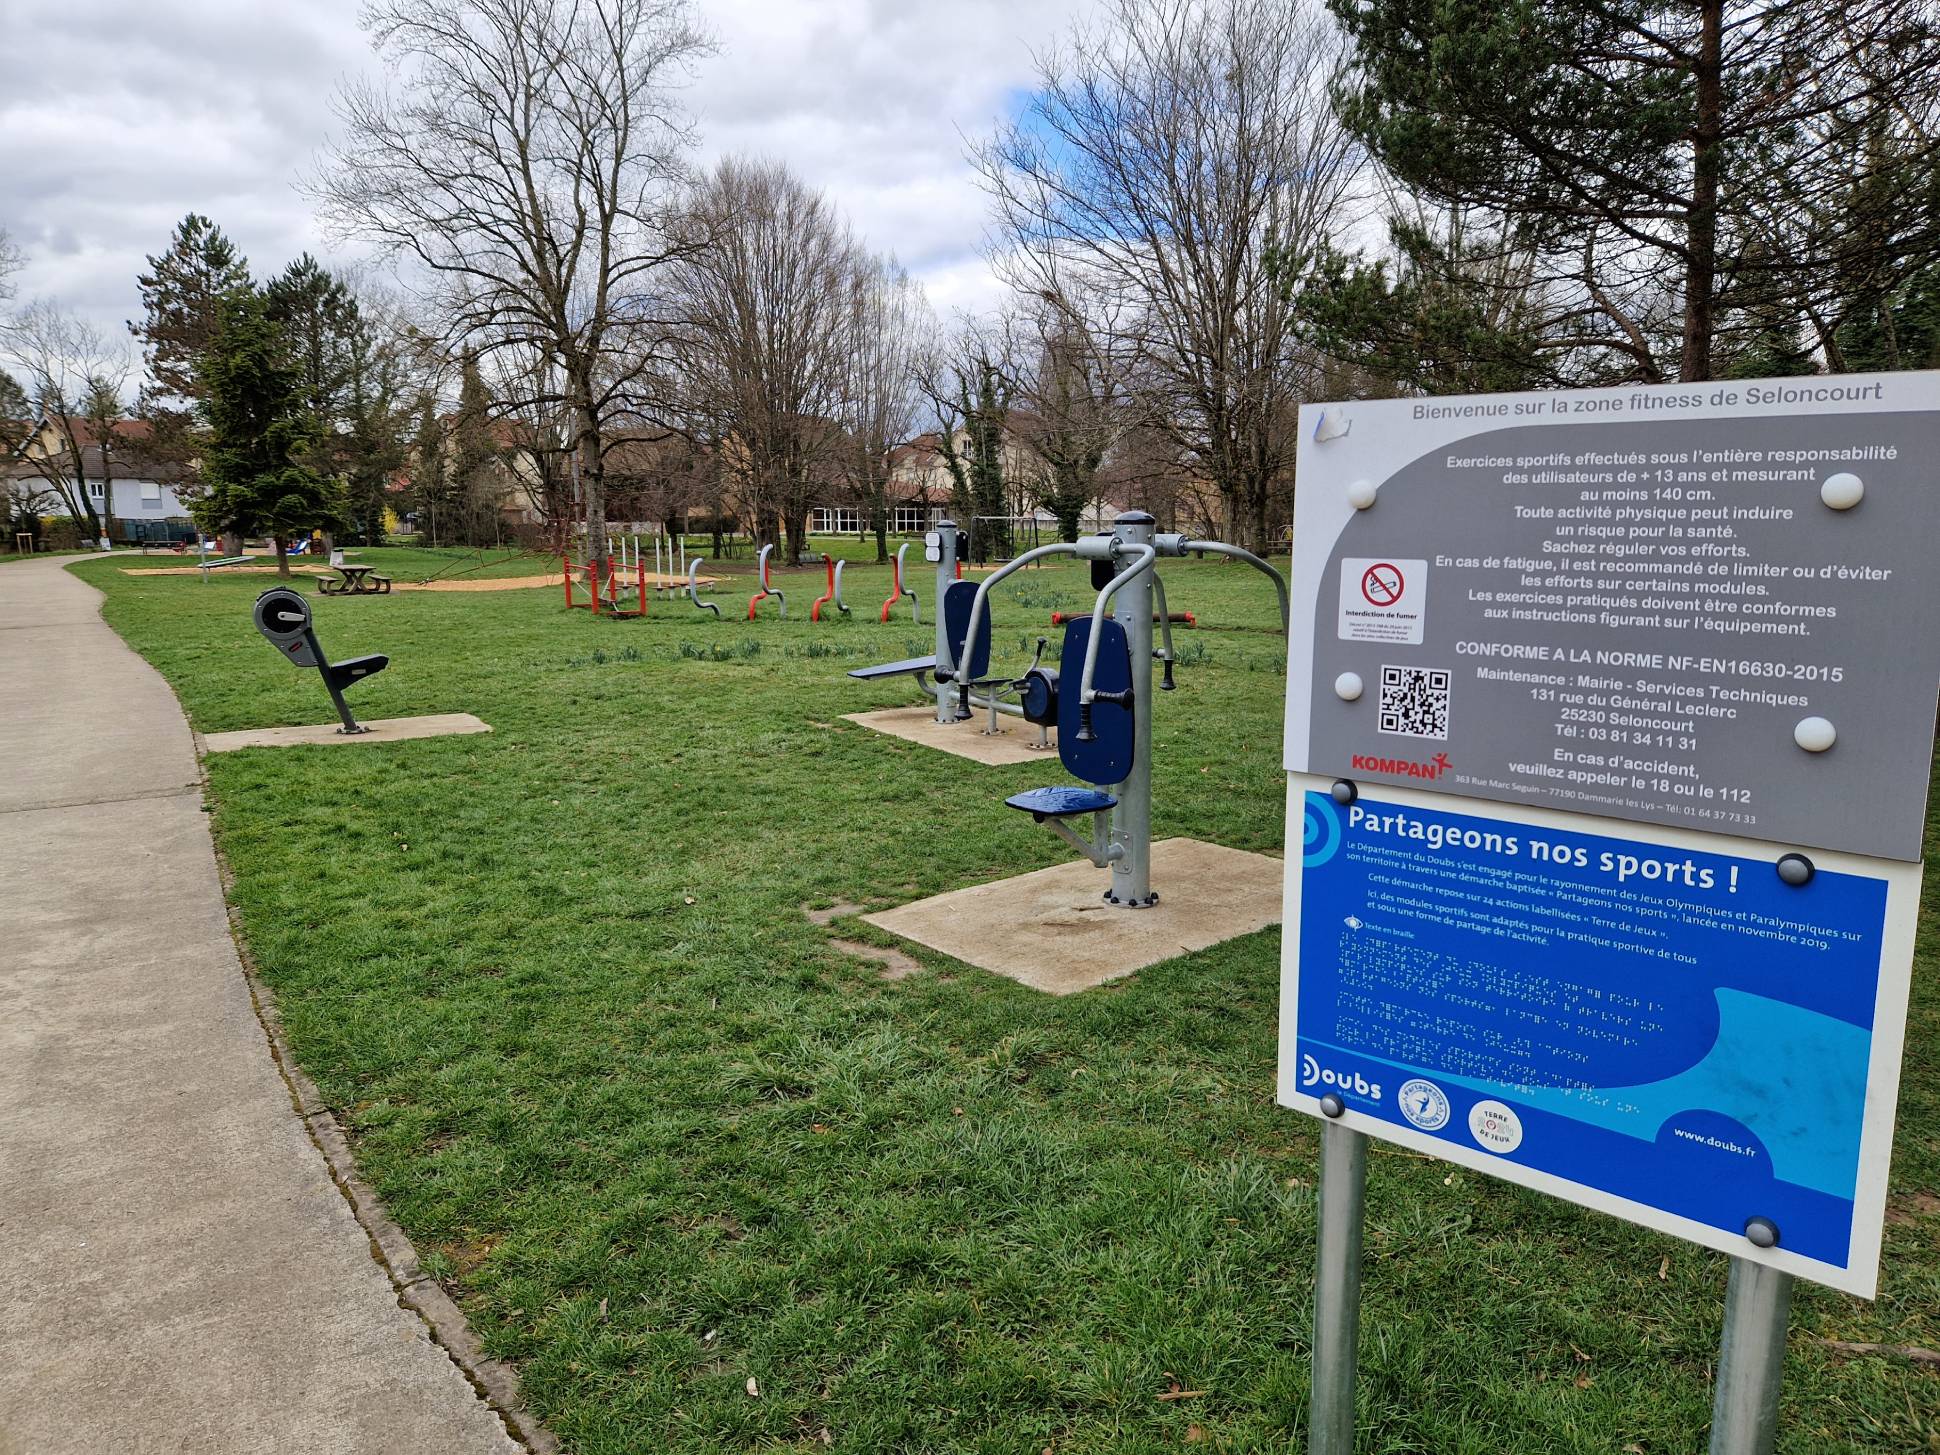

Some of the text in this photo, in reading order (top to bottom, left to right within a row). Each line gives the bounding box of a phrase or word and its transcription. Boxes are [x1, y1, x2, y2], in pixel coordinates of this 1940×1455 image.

[1413, 381, 1883, 420] Bienvenue sur la zone fitness de Seloncourt
[1446, 445, 1897, 469] Exercices sportifs effectués sous l'entière responsabilité
[1502, 466, 1815, 484] des utilisateurs de 13 ans et mesurant
[1580, 487, 1715, 501] au moins 140 cm.
[1514, 505, 1793, 522] Toute activité physique peut induire
[1556, 523, 1737, 539] un risque pour la santé.
[1542, 540, 1750, 557] Sachez réguler vos efforts.
[1435, 554, 1892, 580] En cas de fatigue, il est recommandé de limiter ou d'éviter
[1520, 574, 1769, 595] les efforts sur certains modules.
[1345, 609, 1385, 618] Interdiction
[1468, 588, 1836, 617] Les exercices pratiqués doivent être conformes
[1483, 607, 1810, 635] aux instructions figurant sur l'équipement.
[1455, 640, 1843, 682] CONFORME A LA NORME NF-EN16630-2015
[1476, 666, 1808, 707] Maintenance Mairie Services Techniques
[1530, 687, 1737, 719] 131 rue du Général Leclerc
[1560, 707, 1694, 733] 25230 Seloncourt
[1554, 723, 1696, 751] Tél 03 81 34 11 31
[1352, 754, 1436, 780] KOMPAN
[1553, 747, 1699, 780] En cas d'accident,
[1508, 762, 1751, 803] veuillez appeler le 18 ou le 112
[1455, 774, 1756, 824] 363 Rue Marc Seguin 77190 Dammarie les Lys Tél: 01 64 37 73 33
[1349, 805, 1714, 888] Partageons nos sports
[1347, 840, 1862, 941] Le Département du Doubs s'est engagé pour le rayonnement des Jeux Olympiques et Paralympiques sur
[1362, 854, 1400, 868] territoire
[1401, 861, 1406, 869] à
[1408, 863, 1438, 875] travers
[1439, 870, 1457, 879] une
[1458, 872, 1504, 888] démarche
[1506, 880, 1546, 896] baptisée
[1556, 890, 1612, 908] Partageons
[1614, 902, 1633, 912] nos
[1635, 906, 1668, 919] sports
[1682, 912, 1718, 928] lancée
[1720, 922, 1735, 931] en
[1738, 925, 1797, 943] novembre
[1800, 937, 1830, 952] 2019.
[1303, 1053, 1382, 1100] Doubs
[1484, 1110, 1509, 1123] TERRE
[1674, 1128, 1756, 1158] www.doubs.fr
